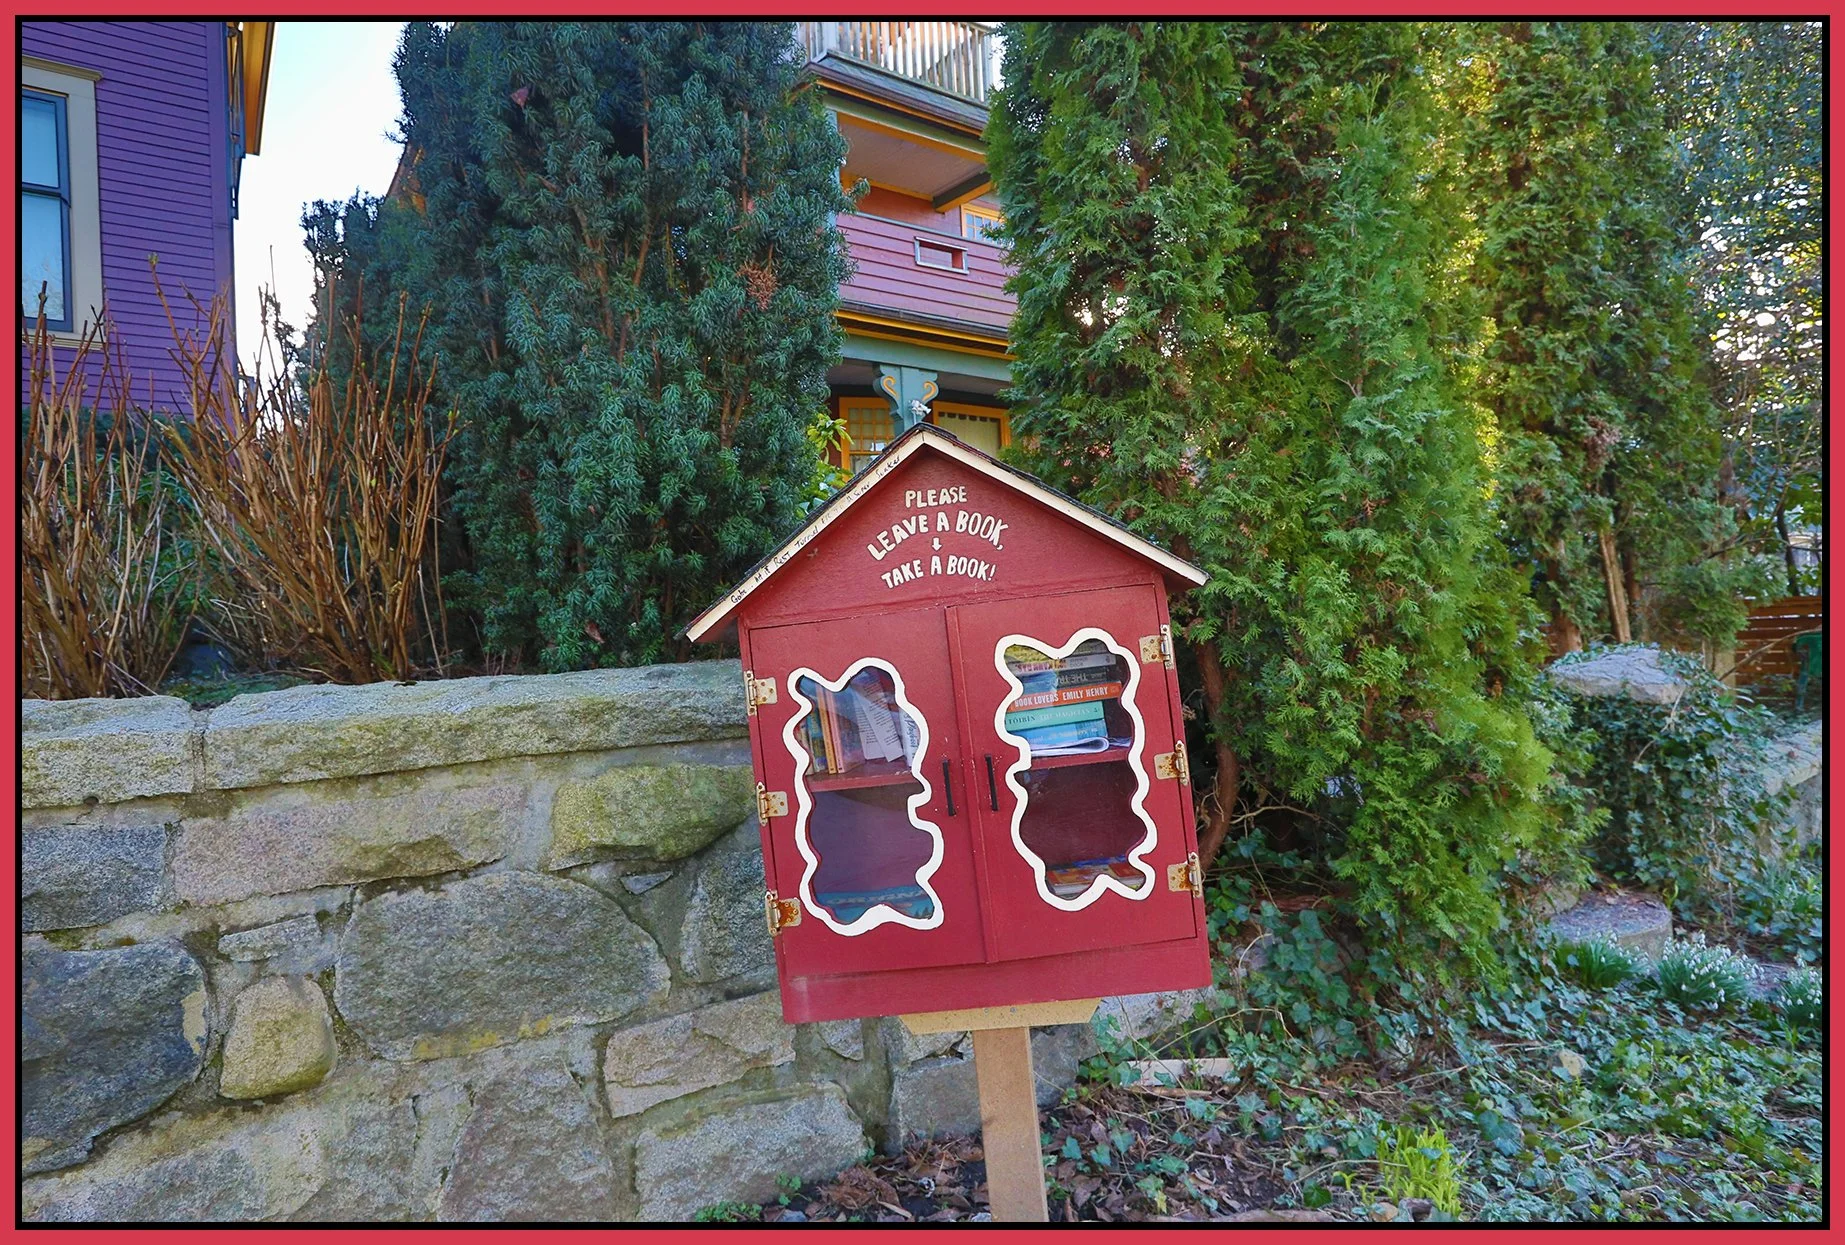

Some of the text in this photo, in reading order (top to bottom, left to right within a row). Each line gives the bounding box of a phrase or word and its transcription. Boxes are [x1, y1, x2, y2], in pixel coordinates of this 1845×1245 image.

[905, 486, 968, 509] PLEASE
[867, 510, 1009, 561] LEAVE A BOOK,
[881, 555, 997, 589] TAKE A BOOK!
[1014, 686, 1109, 708] BOOK LOVERS EMILY HENRY
